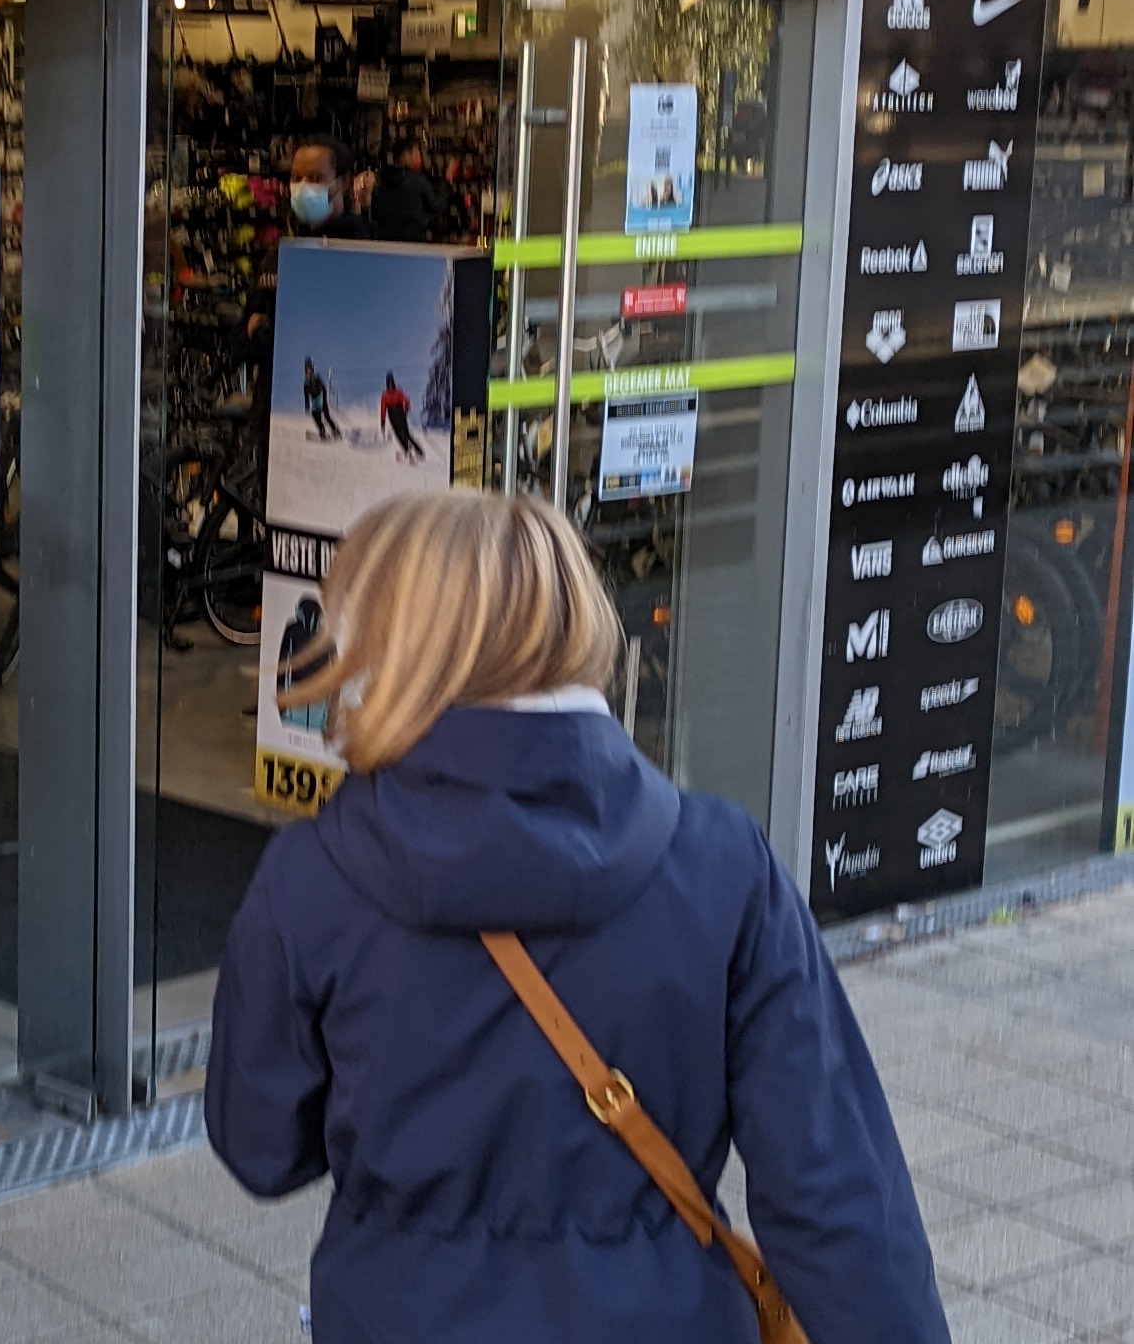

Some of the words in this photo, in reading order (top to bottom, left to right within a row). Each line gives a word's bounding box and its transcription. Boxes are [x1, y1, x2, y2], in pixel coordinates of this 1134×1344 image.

[861, 243, 911, 275] Reebok
[861, 394, 918, 428] Columbia
[858, 472, 916, 503] AIRWALK
[271, 528, 316, 578] VESTE
[851, 539, 893, 581] VANS
